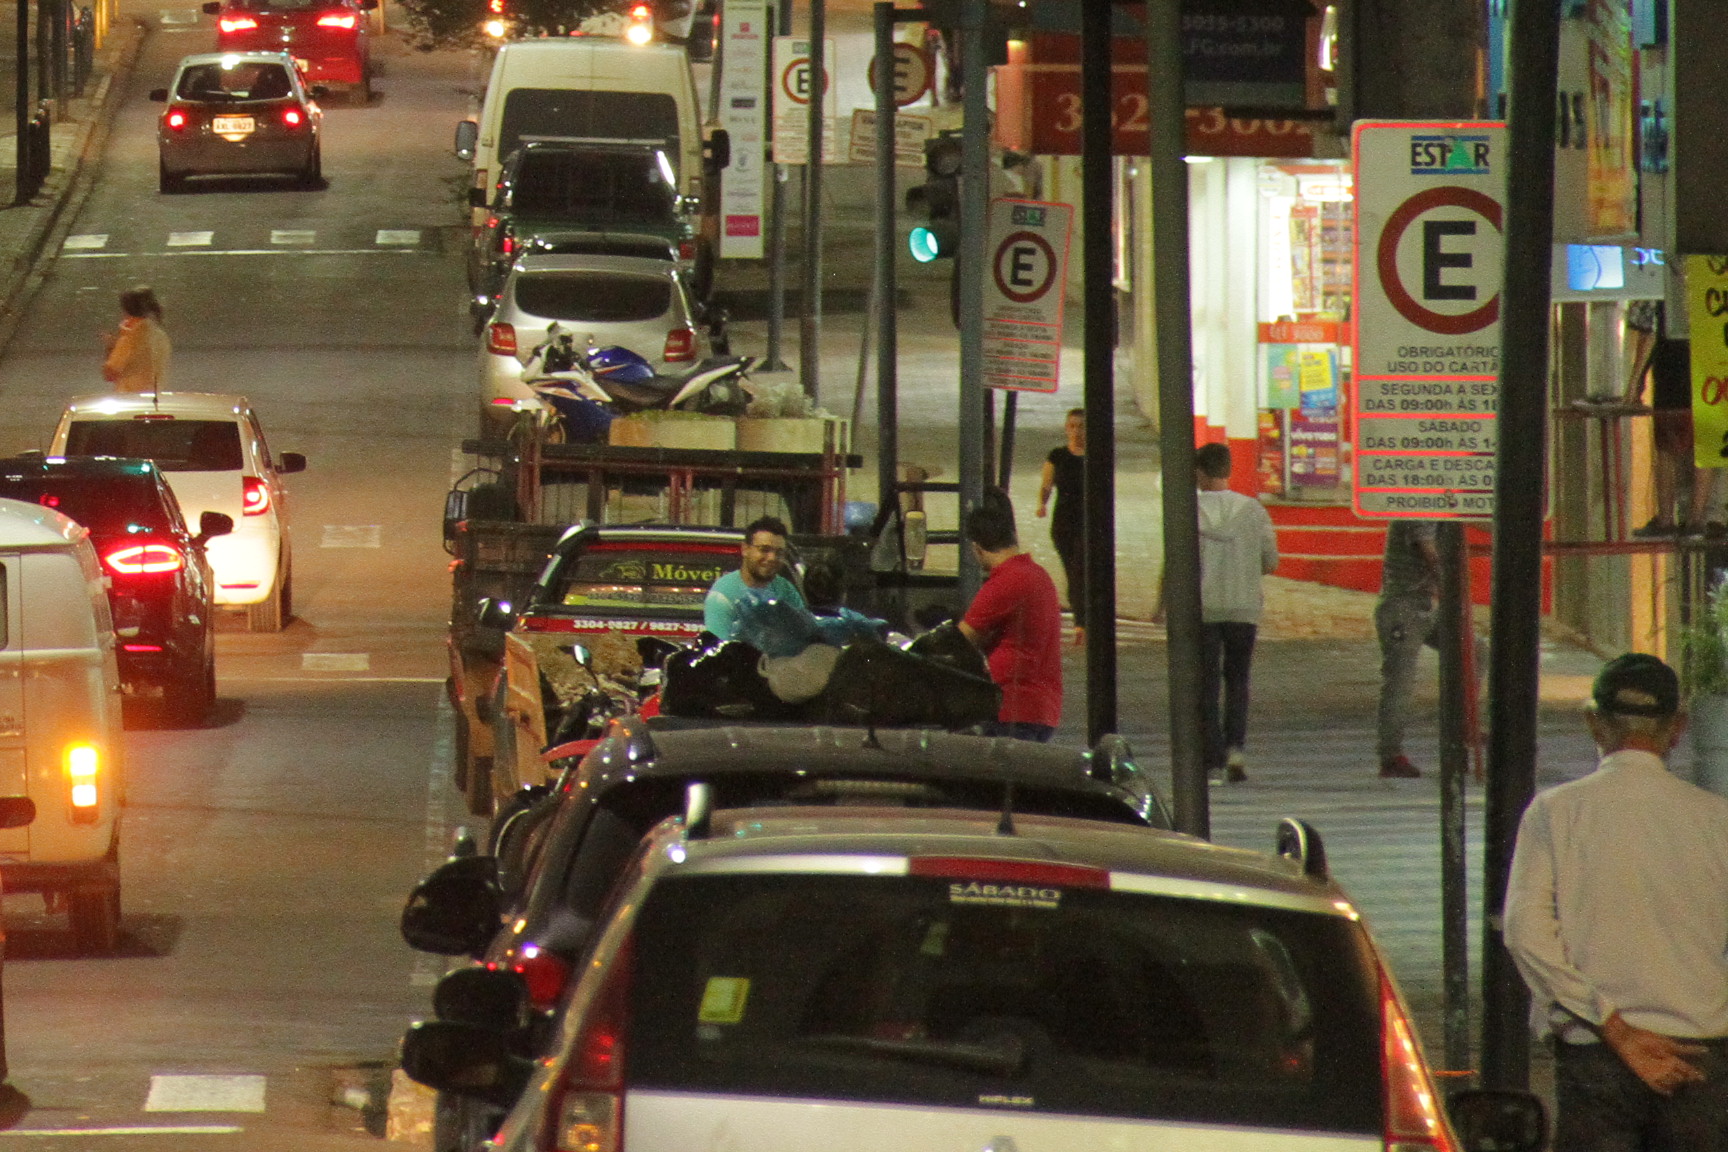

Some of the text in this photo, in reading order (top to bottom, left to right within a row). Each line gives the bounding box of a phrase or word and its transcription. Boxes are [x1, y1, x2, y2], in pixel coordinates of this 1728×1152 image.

[1011, 246, 1036, 286] E
[1423, 220, 1476, 300] E
[1387, 362, 1418, 373] USO
[1423, 361, 1445, 373] DO
[1380, 383, 1498, 396] SEGUNDA A SEX
[1366, 399, 1396, 411] DAS
[1400, 399, 1453, 411] 09:00h
[1366, 437, 1396, 449] DAS
[1401, 437, 1453, 449] 09:00h
[1373, 459, 1495, 471] CARGA E DESCA
[1367, 474, 1396, 486] DAS
[1387, 496, 1493, 509] PROIBIDO MOT
[652, 564, 721, 581] Móvei
